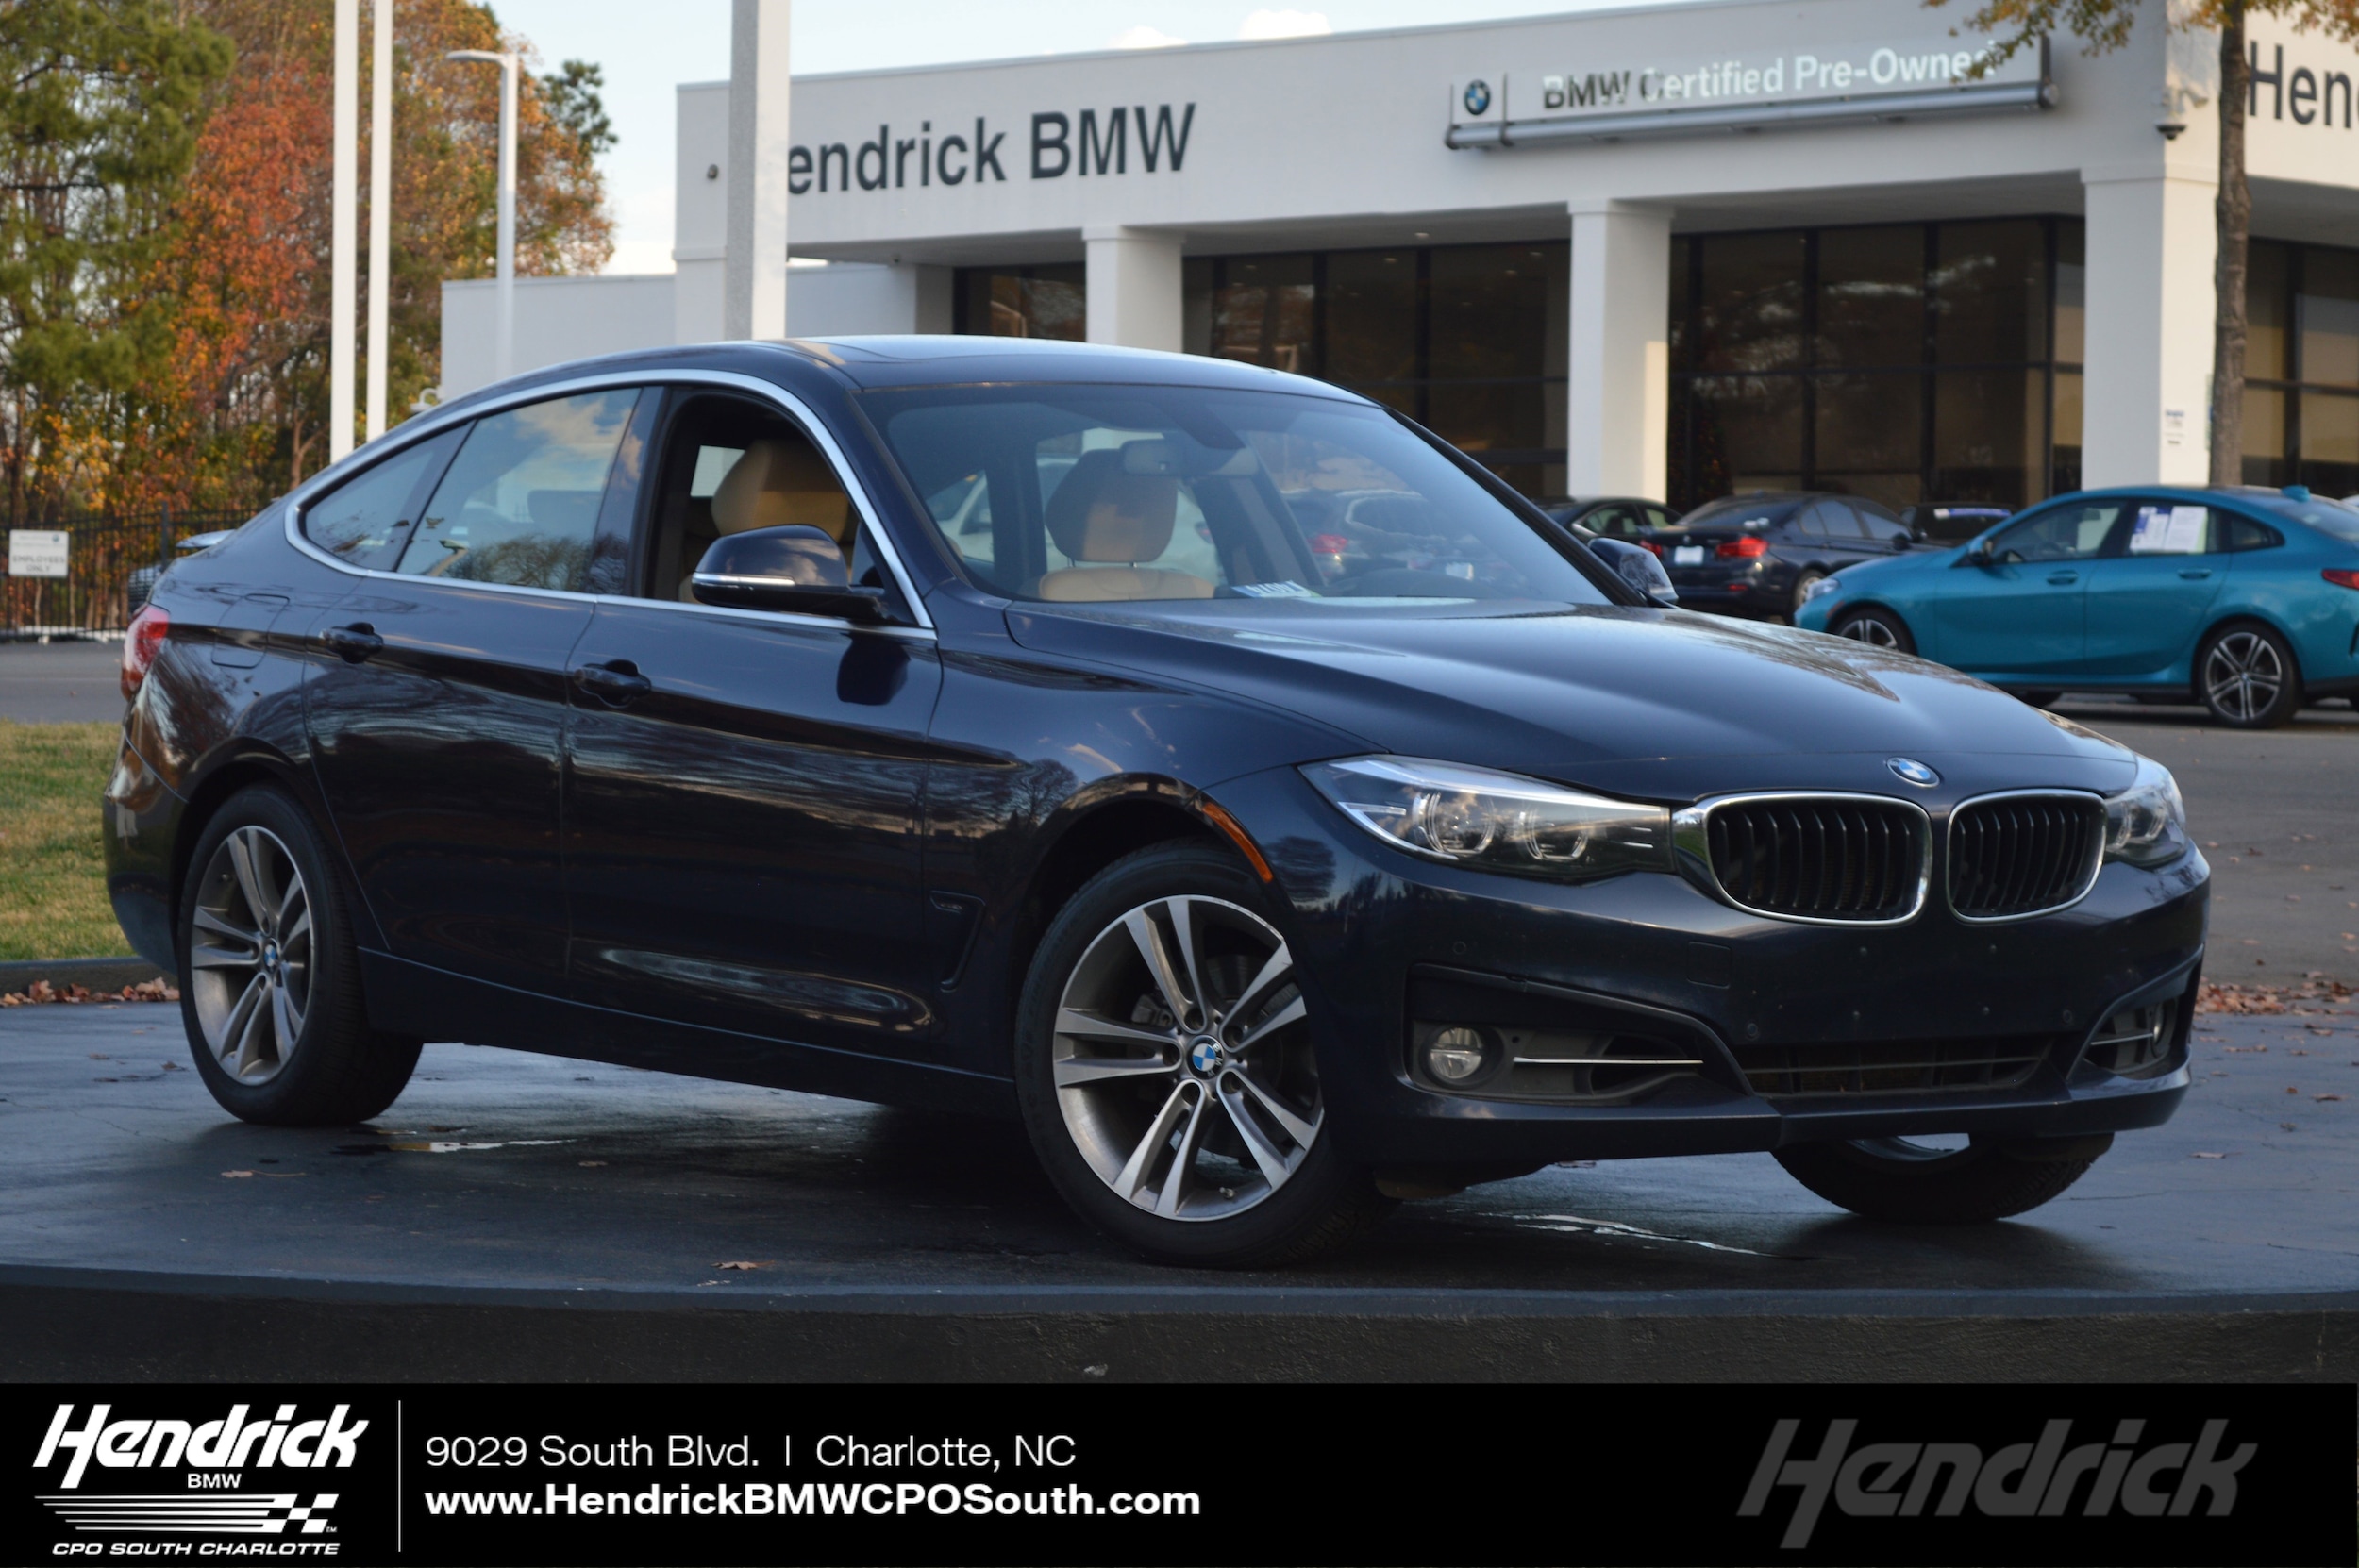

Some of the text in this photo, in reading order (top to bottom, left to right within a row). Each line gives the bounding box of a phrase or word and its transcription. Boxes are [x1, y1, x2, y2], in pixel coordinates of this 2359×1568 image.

[1542, 70, 1631, 108] BMW
[1639, 57, 1783, 102] Certified
[2250, 40, 2359, 129] Hen
[789, 101, 1196, 195] endrick BMW
[12, 555, 65, 563] EMPLOYEES
[26, 564, 50, 573] ONLY
